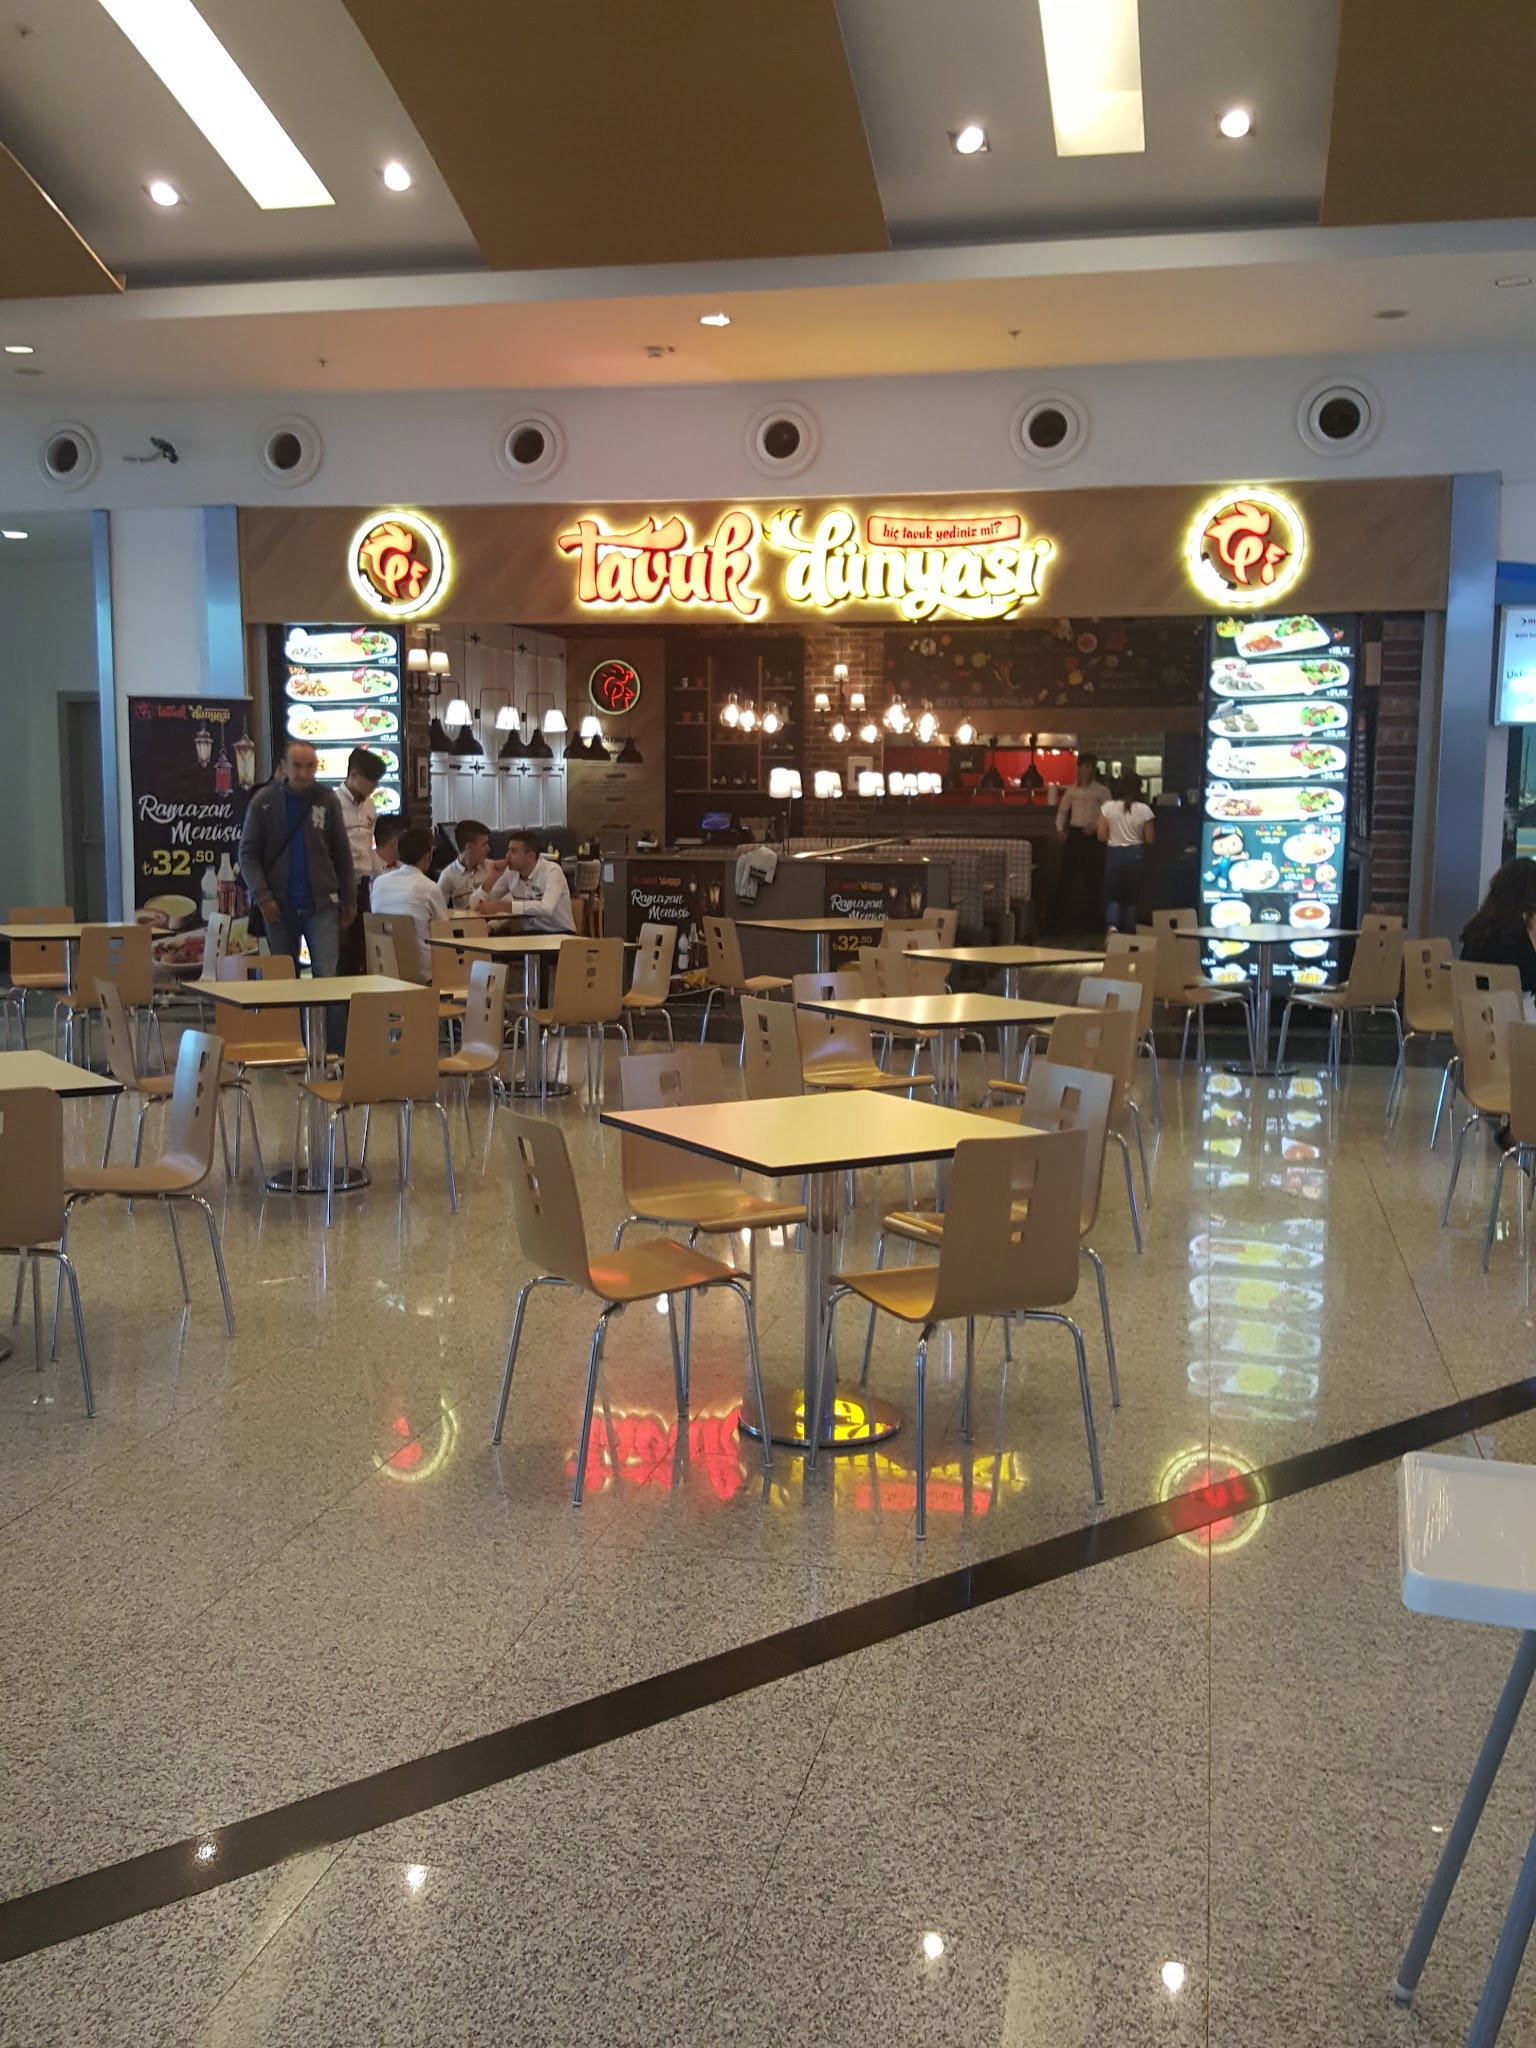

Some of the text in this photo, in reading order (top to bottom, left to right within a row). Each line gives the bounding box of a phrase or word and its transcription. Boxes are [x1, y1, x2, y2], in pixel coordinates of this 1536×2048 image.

[883, 523, 899, 541] hiç
[903, 525, 932, 539] tavuk
[936, 525, 977, 542] yediniz
[558, 508, 1052, 620] tavuk dünyası
[138, 794, 233, 824] Ramazan
[631, 889, 684, 907] Ramazan
[830, 893, 884, 912] Ramazan
